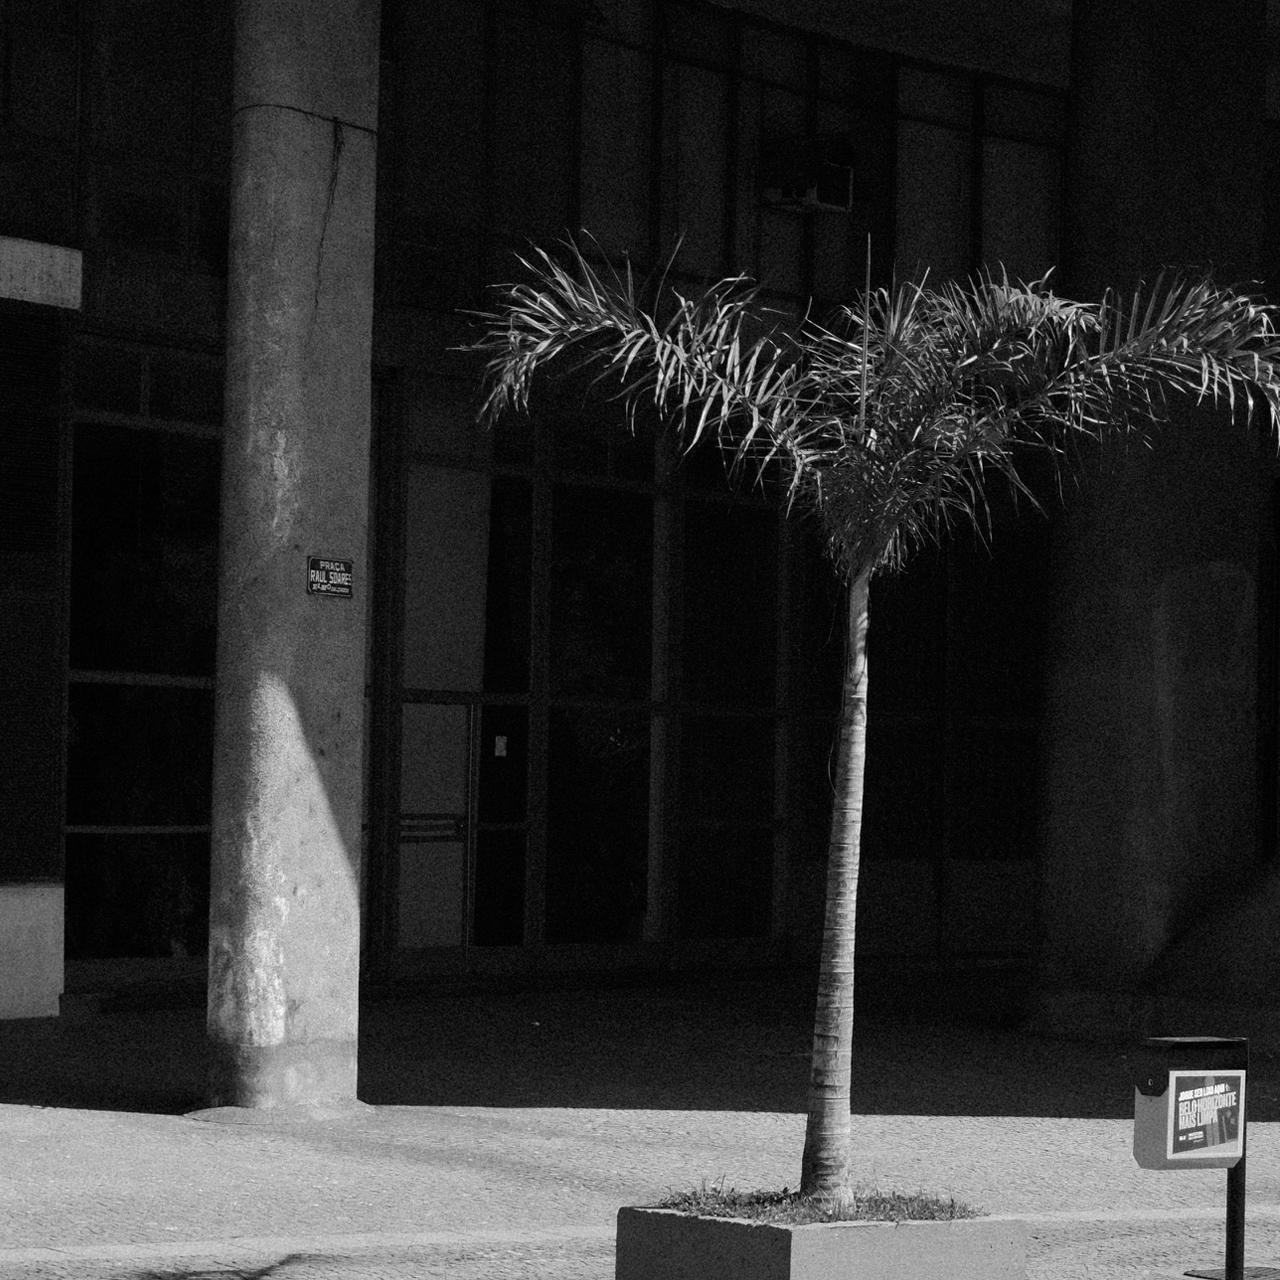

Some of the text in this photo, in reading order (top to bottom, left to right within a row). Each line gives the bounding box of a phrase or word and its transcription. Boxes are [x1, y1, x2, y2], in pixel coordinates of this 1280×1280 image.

[311, 570, 327, 583] RAUL
[1179, 1091, 1237, 1114] BELO HORIZONTE
[1179, 1113, 1197, 1131] MAIS
